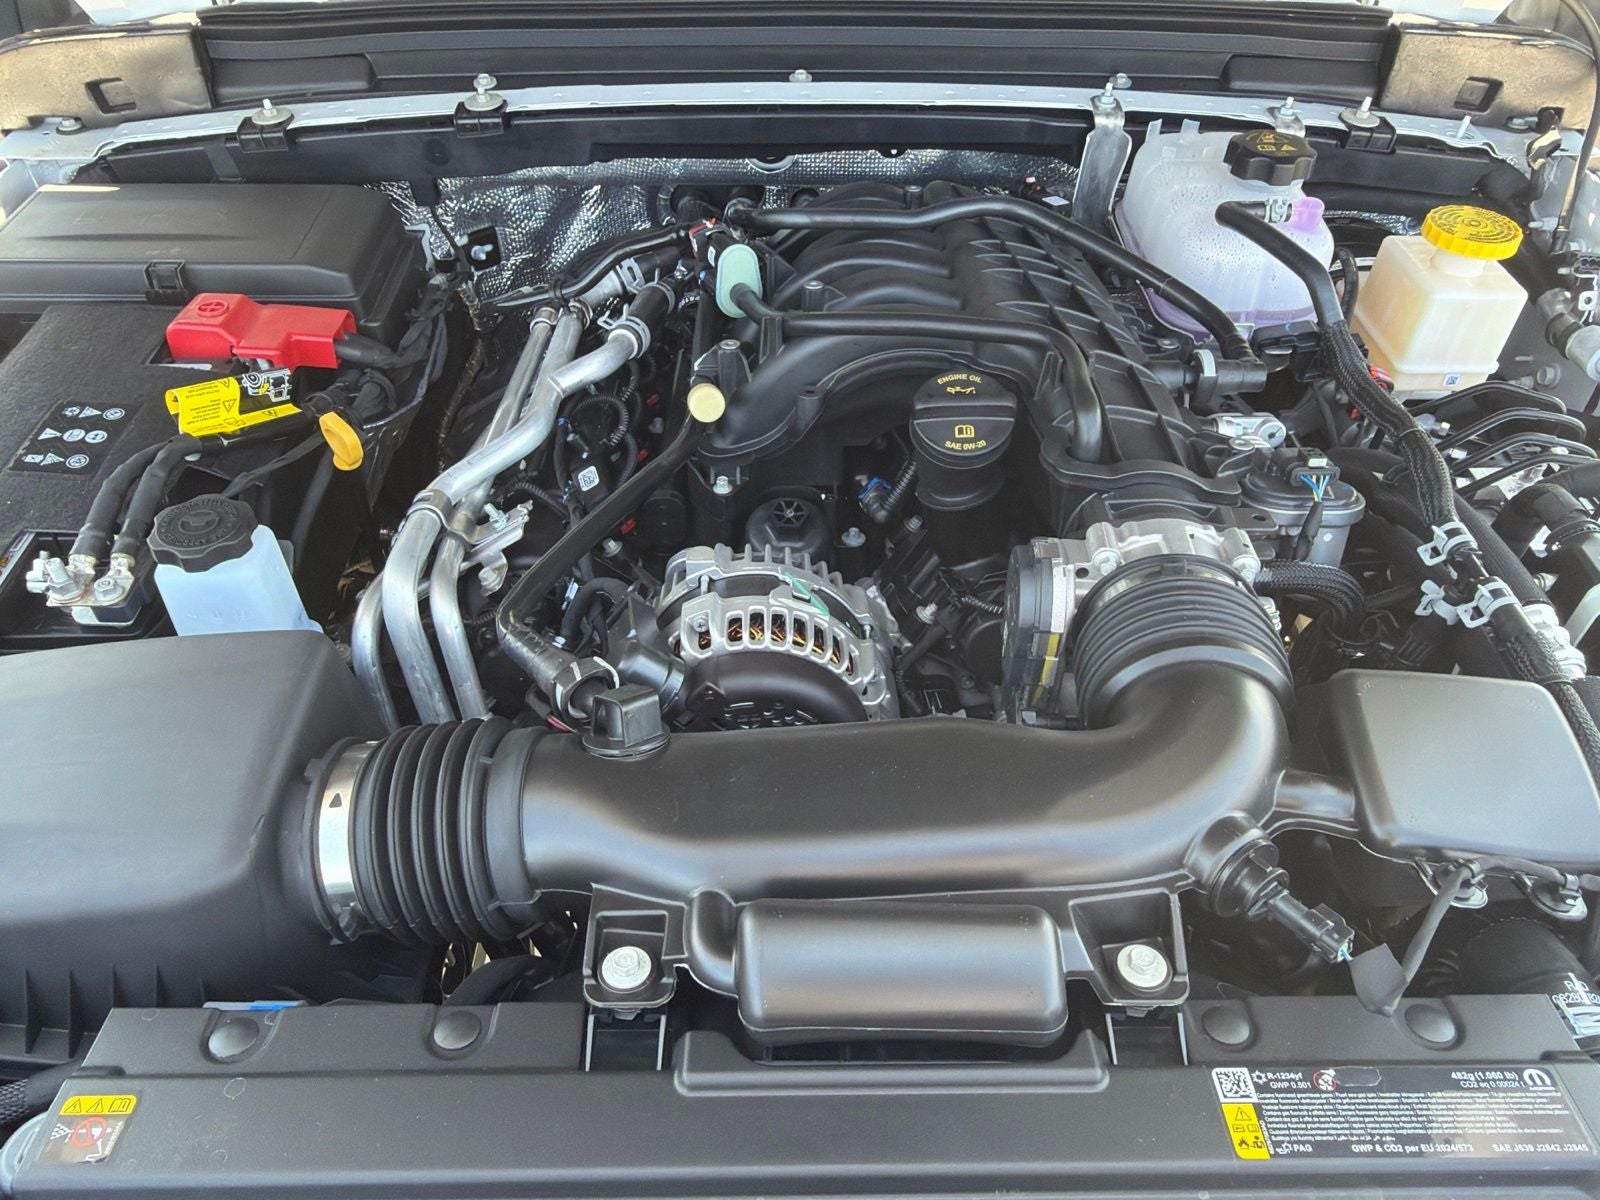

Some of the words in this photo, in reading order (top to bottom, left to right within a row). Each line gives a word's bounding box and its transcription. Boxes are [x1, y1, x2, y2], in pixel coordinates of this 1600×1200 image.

[937, 373, 967, 384] ENGINE
[969, 374, 982, 383] OIL
[944, 440, 961, 450] SAE
[963, 440, 986, 450] 0W-20
[1270, 1081, 1289, 1089] GWP
[1460, 1080, 1479, 1088] CO2
[1293, 1144, 1313, 1152] PAG
[1351, 1144, 1373, 1152] GWP
[1375, 1144, 1383, 1152] &
[1383, 1144, 1403, 1153] CO2
[1404, 1144, 1419, 1153] per
[1420, 1143, 1435, 1152] EU
[1491, 1143, 1513, 1152] SAE
